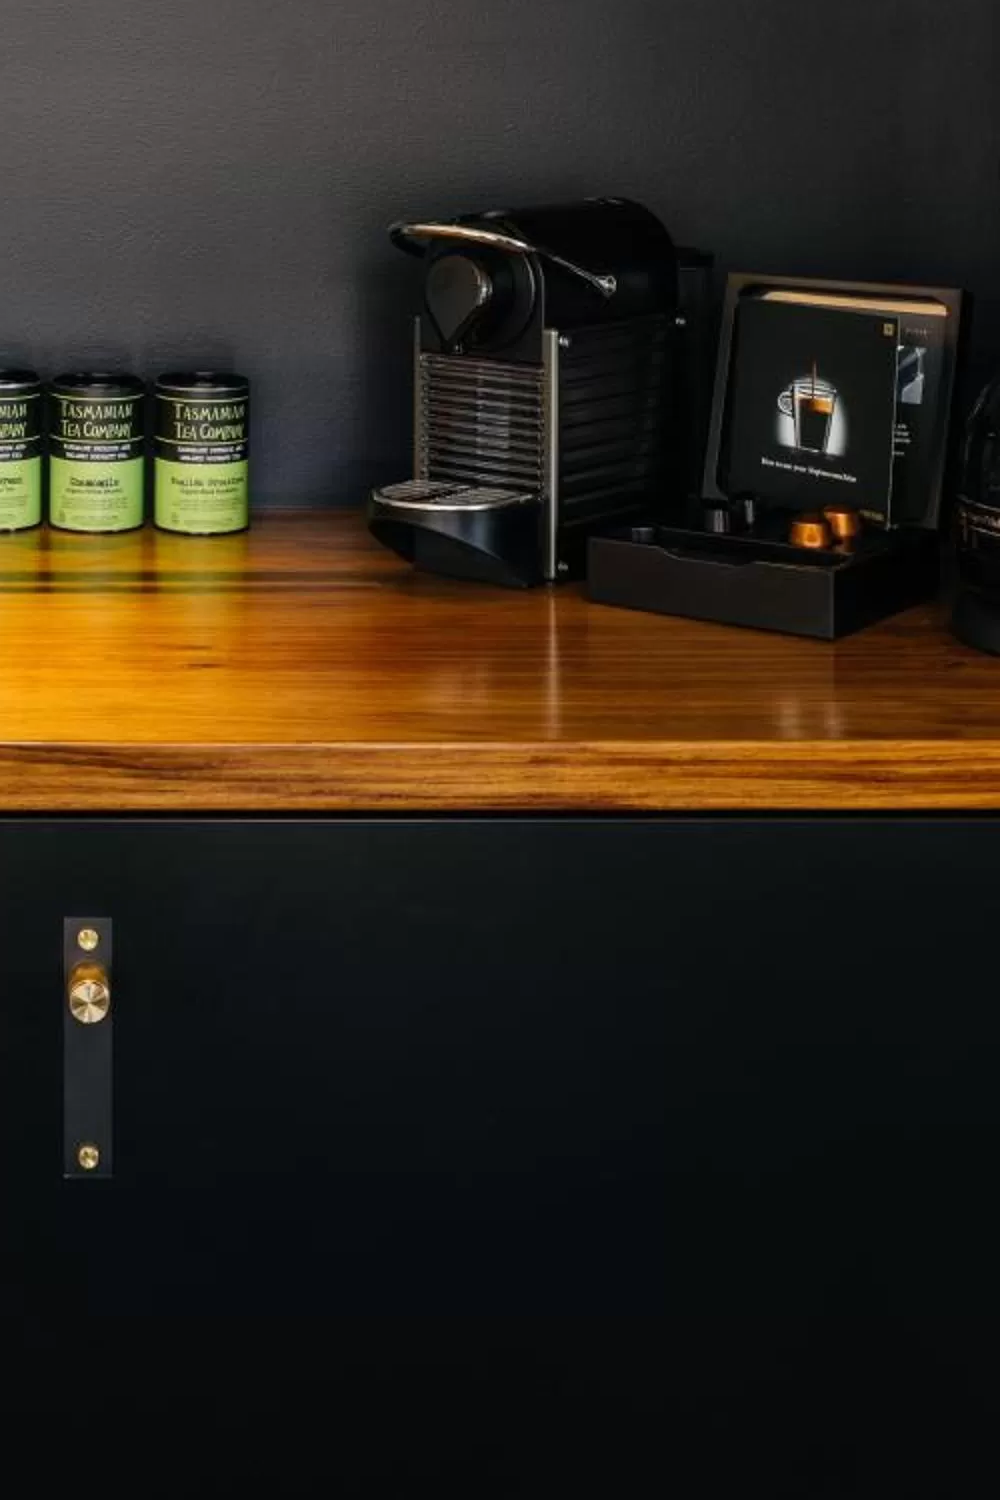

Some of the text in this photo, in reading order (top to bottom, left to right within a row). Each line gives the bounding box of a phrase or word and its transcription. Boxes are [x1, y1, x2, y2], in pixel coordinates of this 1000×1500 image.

[60, 400, 132, 419] TASMANIAN
[174, 402, 245, 420] TASMANIAN
[61, 420, 131, 439] TEA COMPANY
[174, 422, 245, 440] TEA COMPANY
